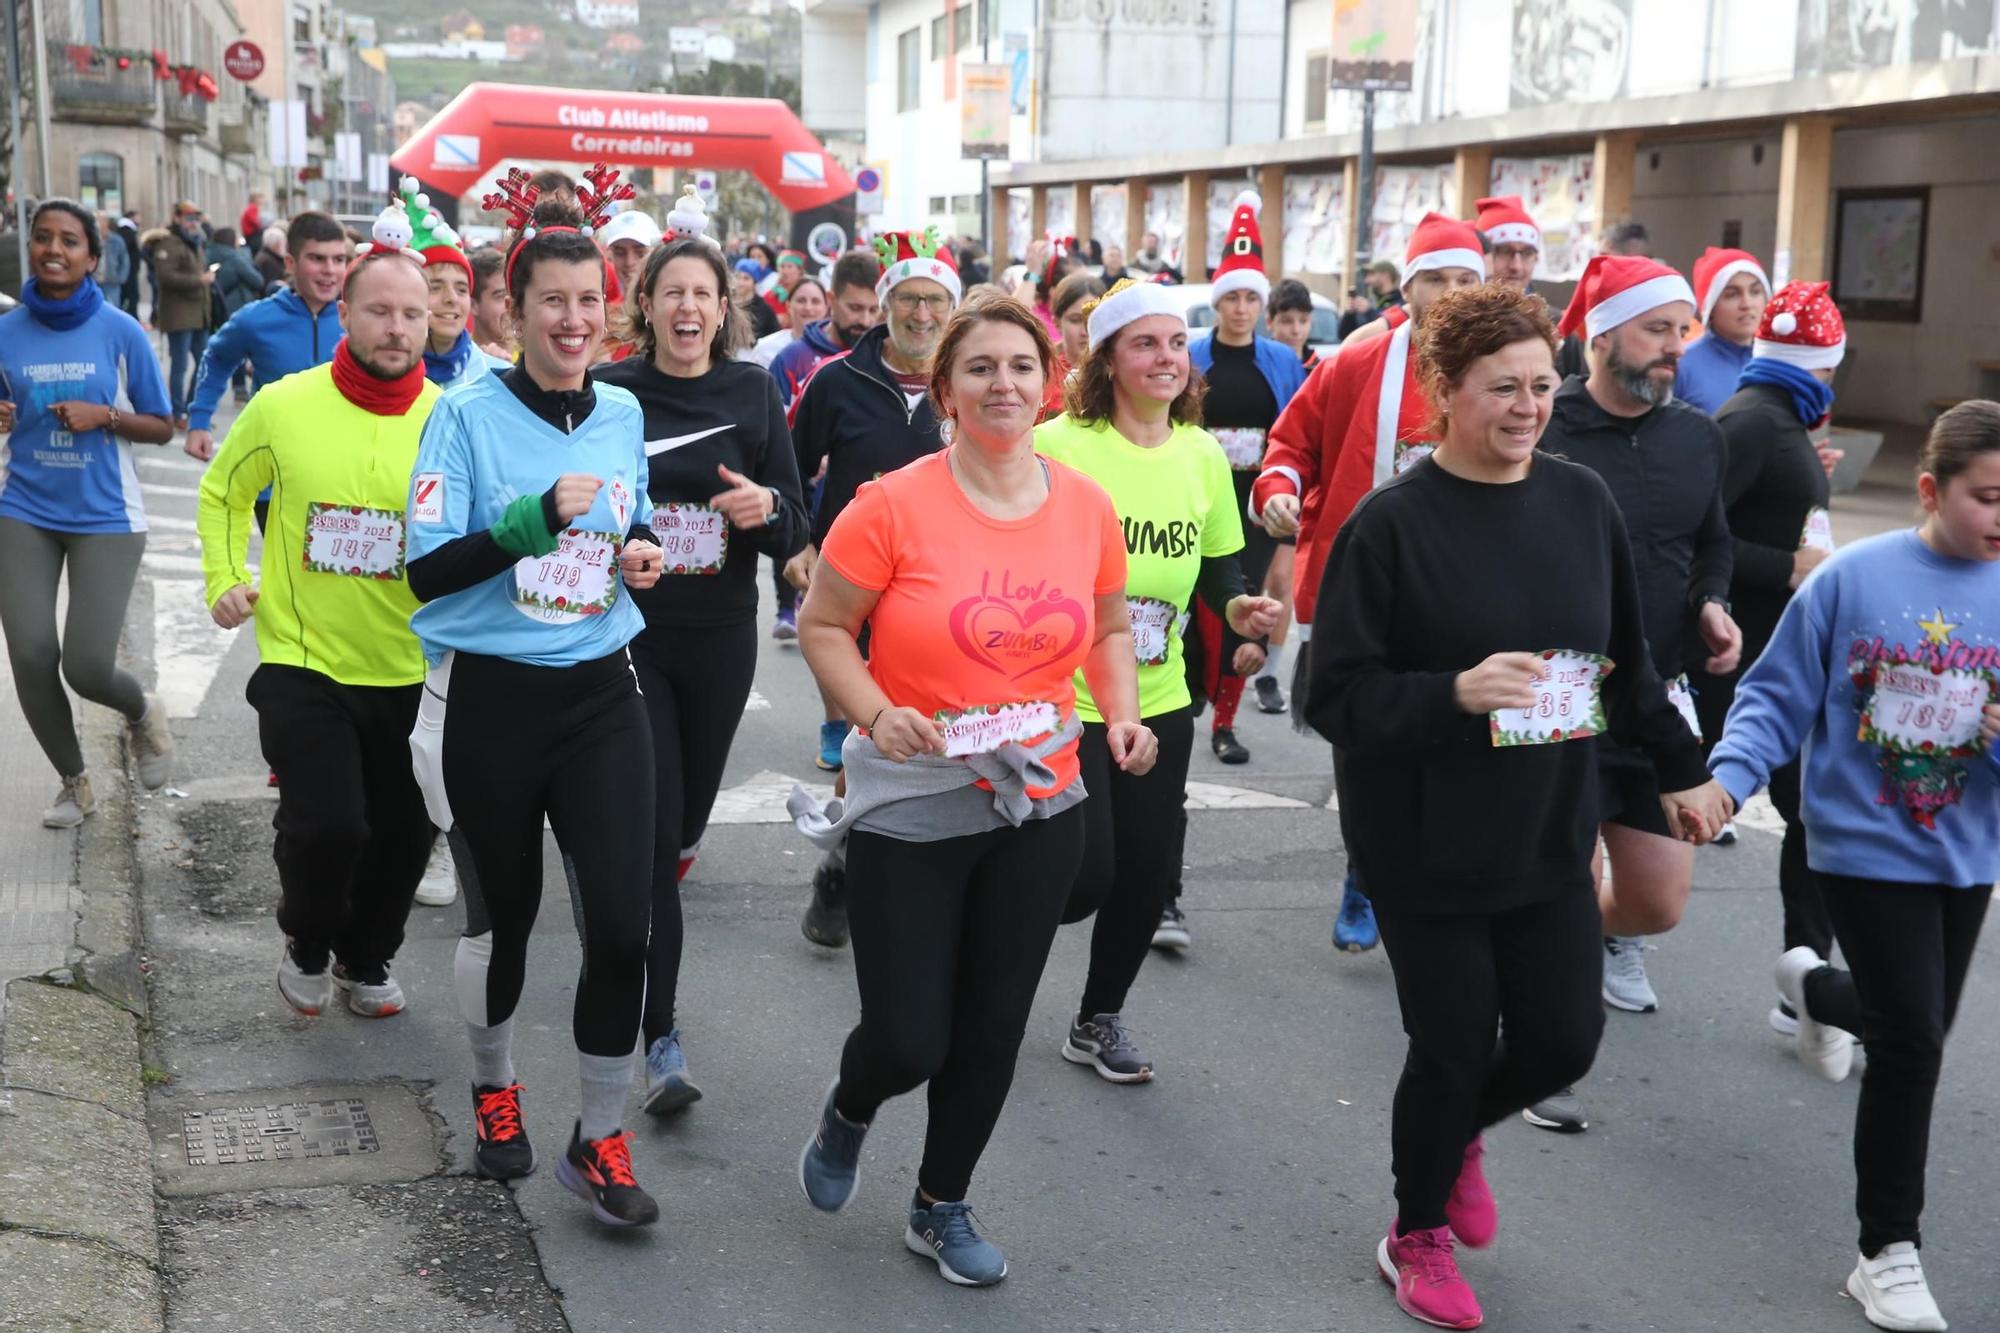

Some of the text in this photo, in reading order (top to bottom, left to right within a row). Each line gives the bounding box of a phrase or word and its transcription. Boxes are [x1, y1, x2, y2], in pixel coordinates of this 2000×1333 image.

[558, 104, 709, 133] Club Atletismo
[571, 132, 694, 157] Corredoiras
[331, 538, 375, 560] 147
[1120, 516, 1198, 558] UMBA
[538, 562, 581, 588] 149
[982, 569, 1065, 602] I Love
[985, 630, 1058, 652] ZUMBA
[1896, 701, 1957, 732] 184
